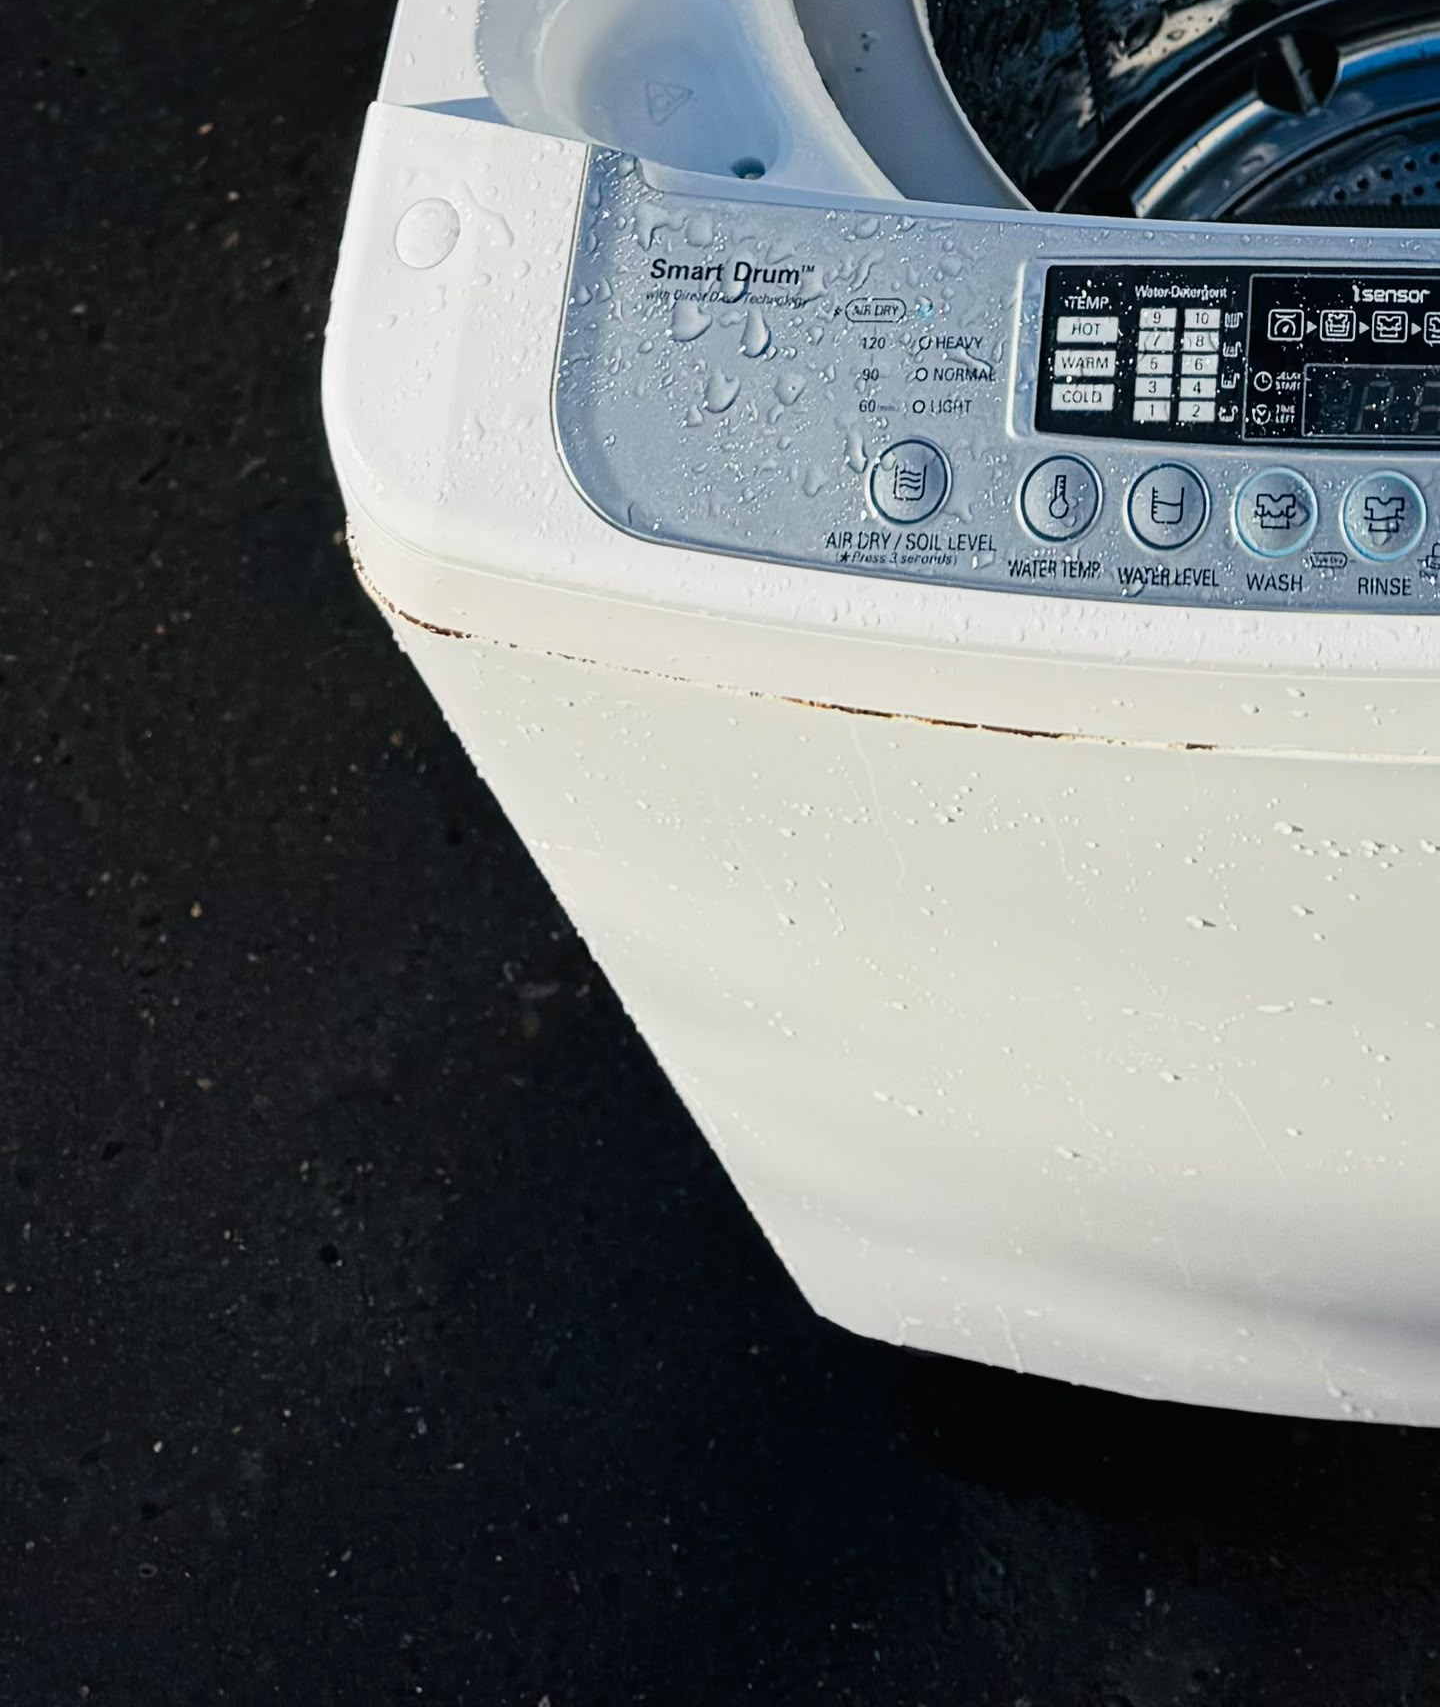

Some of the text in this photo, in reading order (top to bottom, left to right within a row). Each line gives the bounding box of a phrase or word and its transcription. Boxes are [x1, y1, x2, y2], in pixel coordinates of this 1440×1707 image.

[650, 258, 724, 282] Smart
[852, 304, 899, 316] AIR DRY
[1153, 311, 1161, 324] 9
[1195, 312, 1209, 325] 10
[1071, 322, 1101, 336] HOT
[862, 337, 886, 350] 120
[936, 336, 983, 350] HEAVY
[1154, 334, 1161, 347] 7
[1195, 335, 1204, 347] 8
[1061, 356, 1109, 370] WARM
[1150, 357, 1158, 370] 5
[1194, 358, 1203, 371] 6
[862, 368, 880, 382] 90
[933, 368, 996, 382] NORMAL
[1148, 381, 1157, 394] 3
[1192, 382, 1202, 394] 4
[1062, 390, 1102, 404] COLD
[931, 400, 973, 413] LIGHT
[1149, 405, 1154, 417] 1
[1192, 405, 1200, 418] 2
[825, 531, 852, 550] AIR
[857, 531, 892, 551] DRY
[905, 532, 941, 552] SOIL
[948, 533, 998, 552] LEVEL
[1009, 560, 1056, 578] WATER
[1118, 566, 1219, 587] WATER LEVEL
[1246, 573, 1303, 592] WASH
[1357, 577, 1412, 595] RINSE
